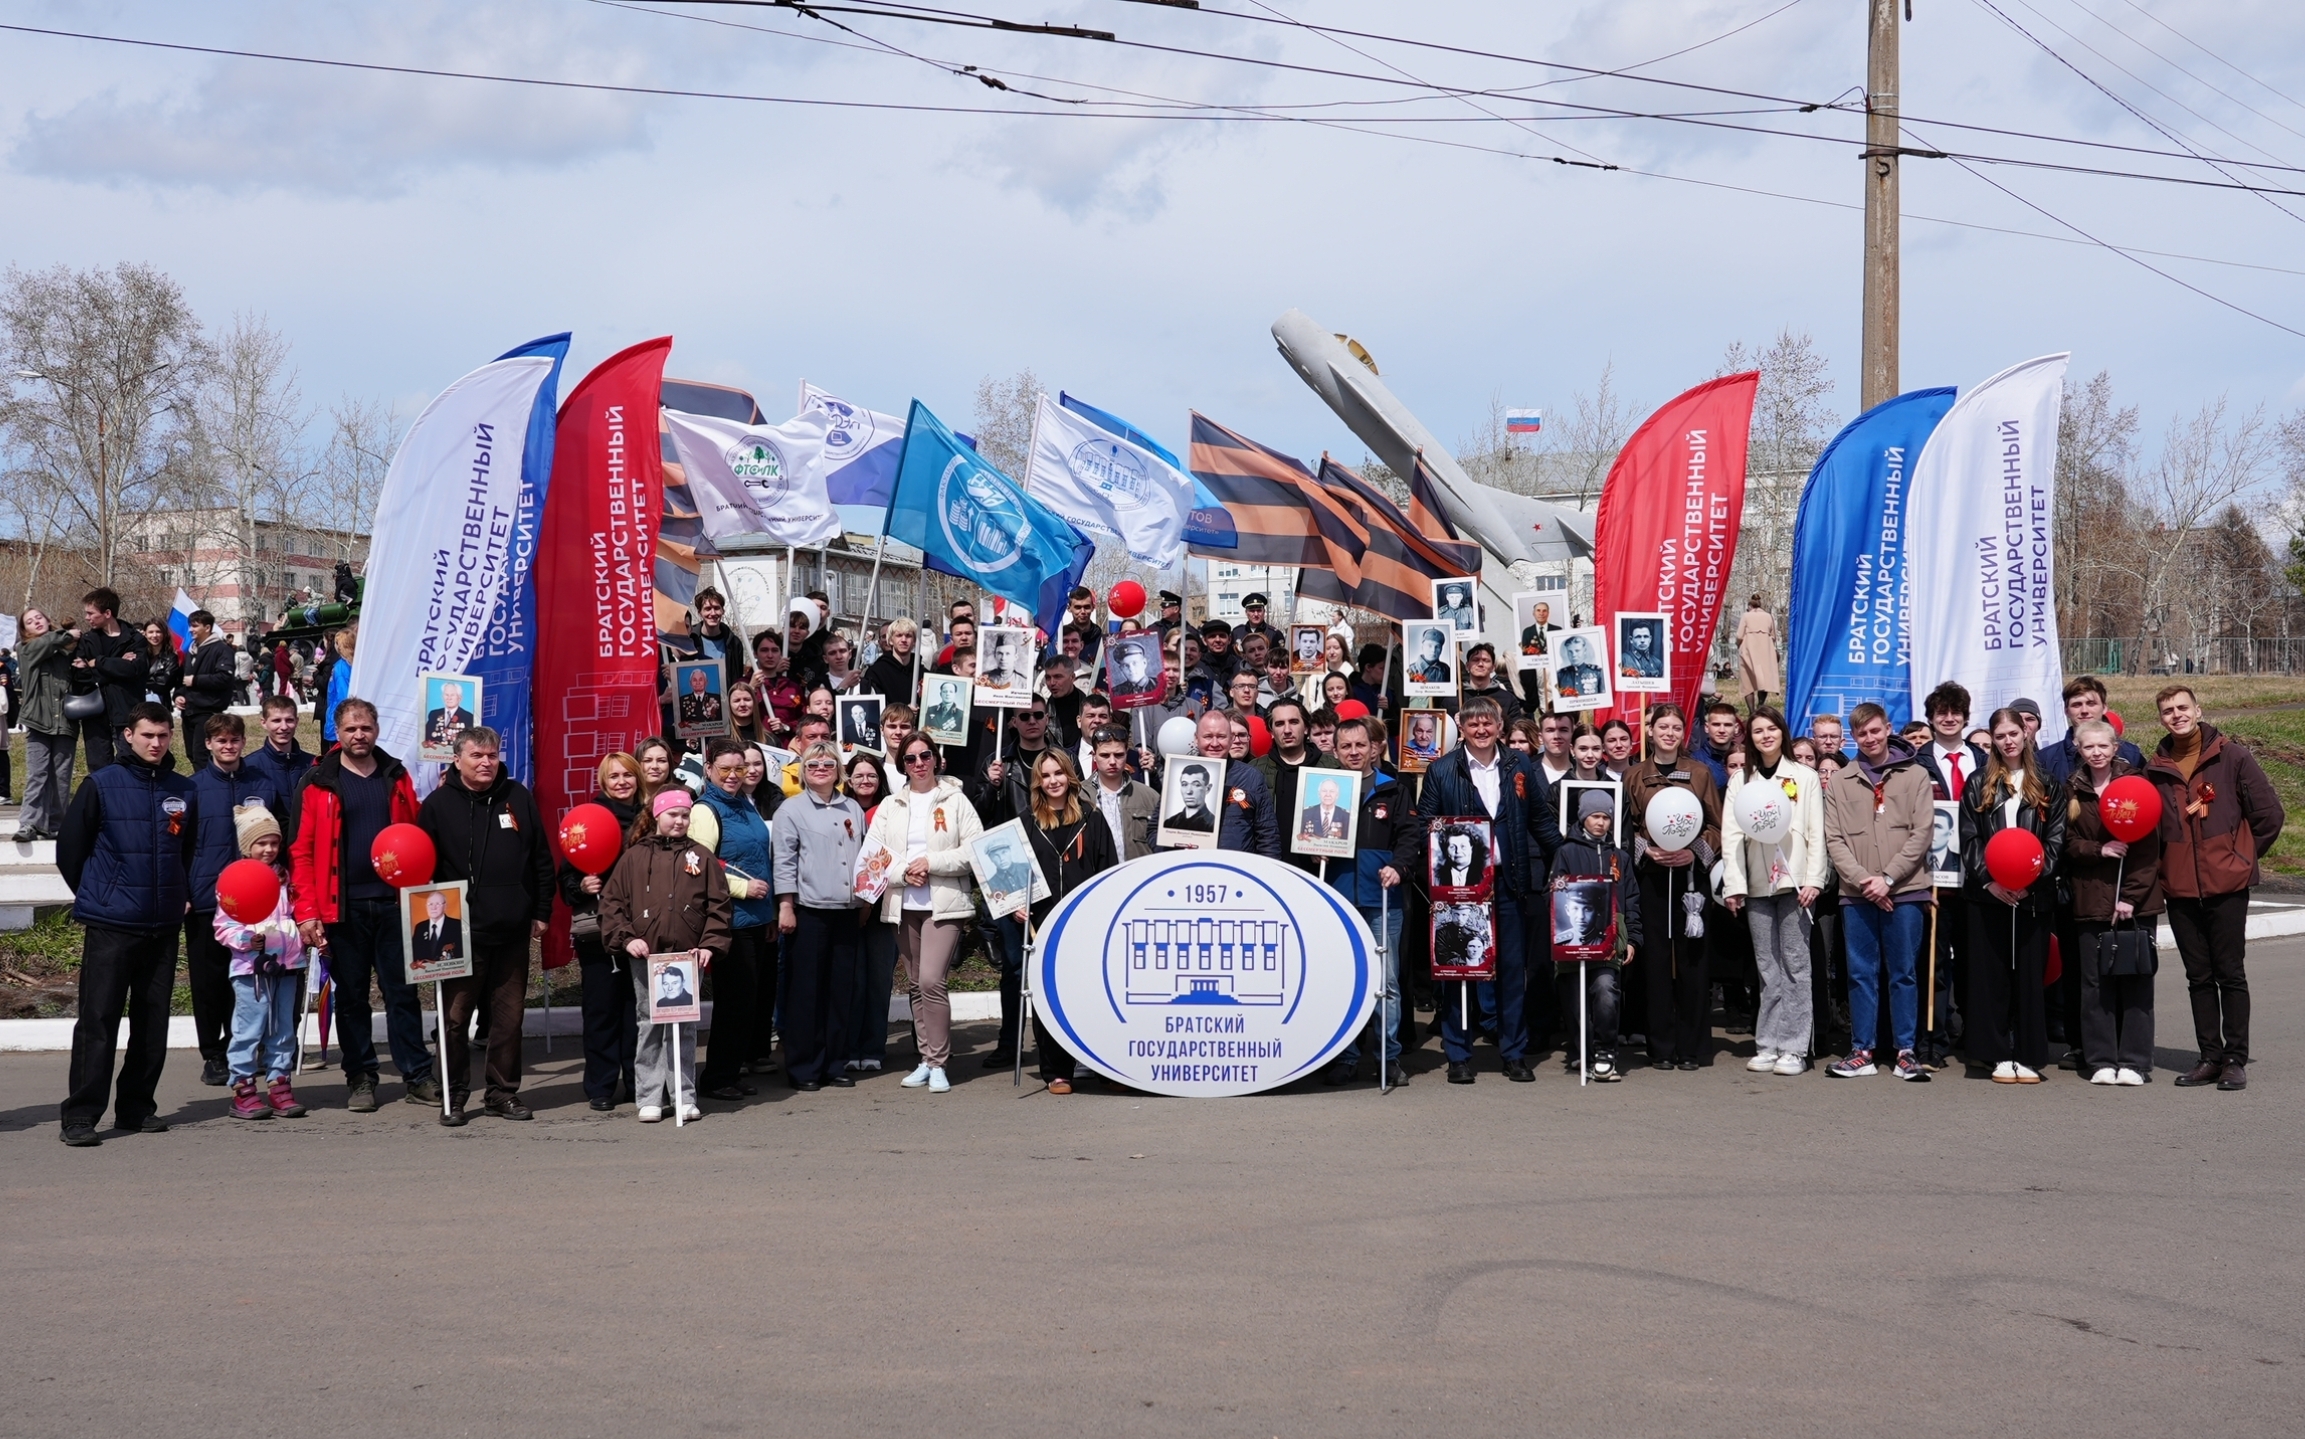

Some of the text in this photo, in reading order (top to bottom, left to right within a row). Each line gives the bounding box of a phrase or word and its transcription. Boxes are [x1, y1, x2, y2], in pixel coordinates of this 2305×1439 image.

[434, 422, 495, 673] ОСУДАРСТВЕННЫЙ
[605, 405, 637, 658] ГОСУДАРСТВЕННЫЙ
[1190, 511, 1213, 524] ТОВ
[1678, 428, 1708, 653] ГОСУДАРСТВЕННЫЙ
[1872, 446, 1905, 665] ГОСУДАРСТВЕННЫЙ
[1999, 420, 2025, 649] ГОСУДАРСТВЕННЫЙ
[2031, 485, 2048, 648] УНИВЕРСИТЕТ
[590, 532, 613, 659] БРАТСКИЙ
[1848, 553, 1873, 664] БРАТСКИЙ
[1975, 535, 2003, 651] БРАТСКИЙ
[1185, 884, 1228, 904] 1957
[1128, 1037, 1282, 1060] ГОСУДАРСТВЕННЫЙ
[1151, 1064, 1259, 1083] УНИВЕРСИТЕТ
[1165, 1012, 1245, 1033] БРАТСКИЙ
